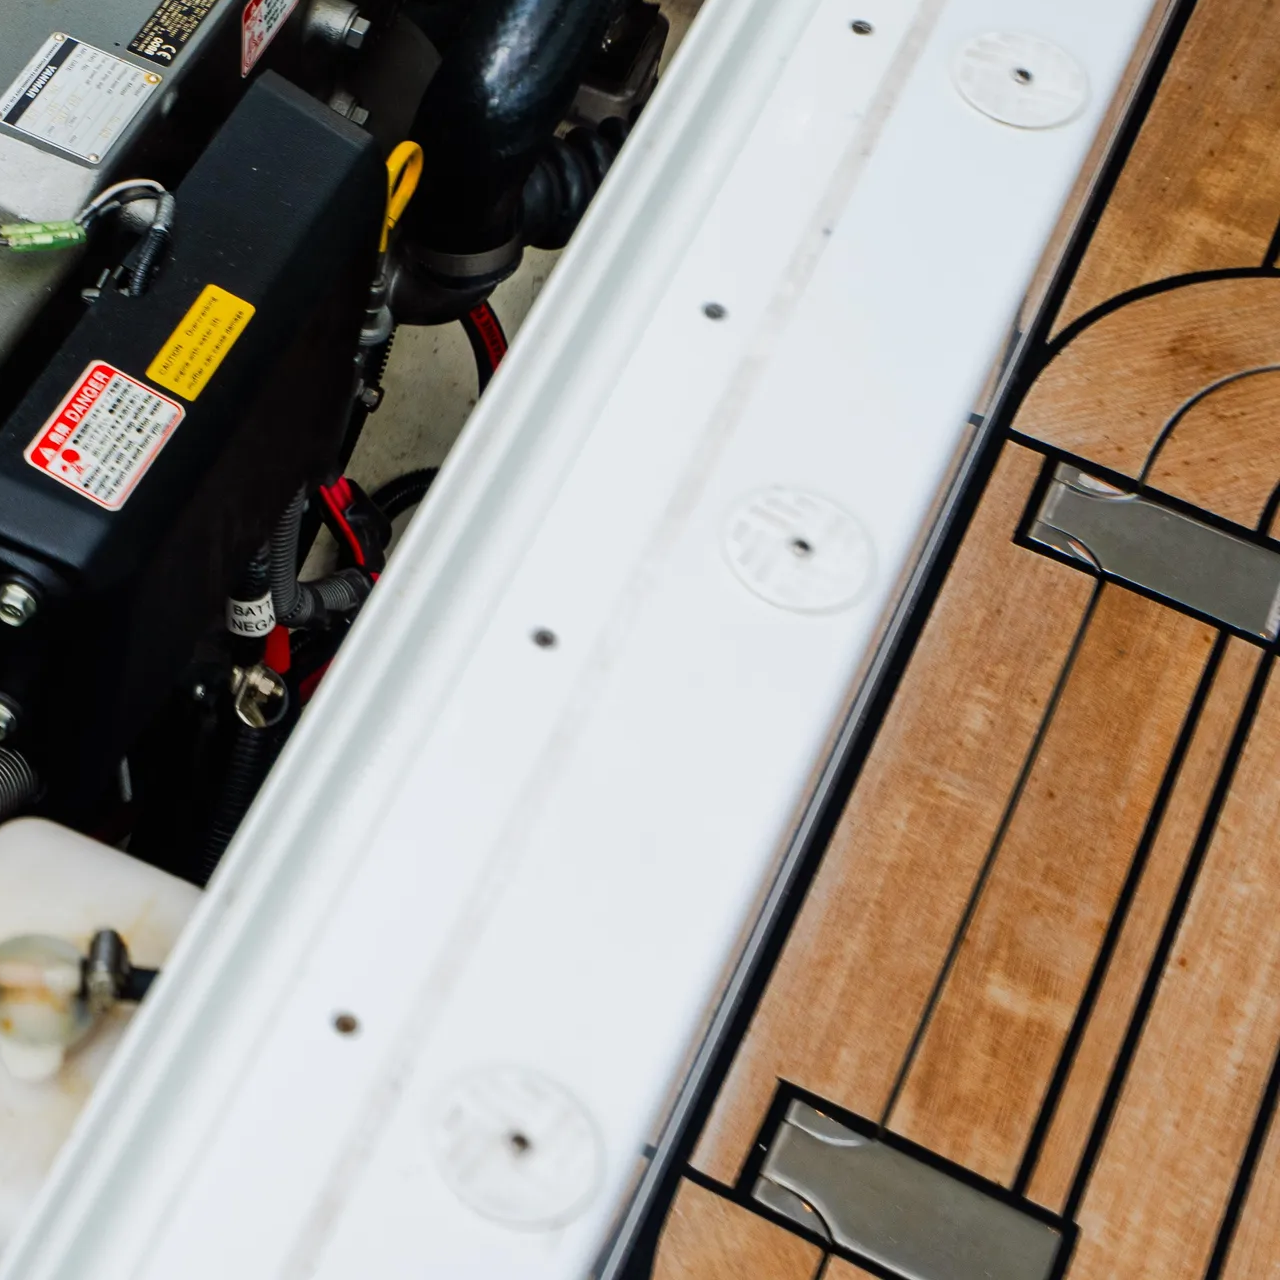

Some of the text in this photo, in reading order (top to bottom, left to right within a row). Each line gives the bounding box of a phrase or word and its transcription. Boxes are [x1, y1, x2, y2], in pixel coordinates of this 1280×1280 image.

[26, 66, 56, 97] YANMAR
[159, 344, 182, 374] CAUTION
[65, 371, 107, 421] DANGER
[231, 614, 274, 631] NEGA
